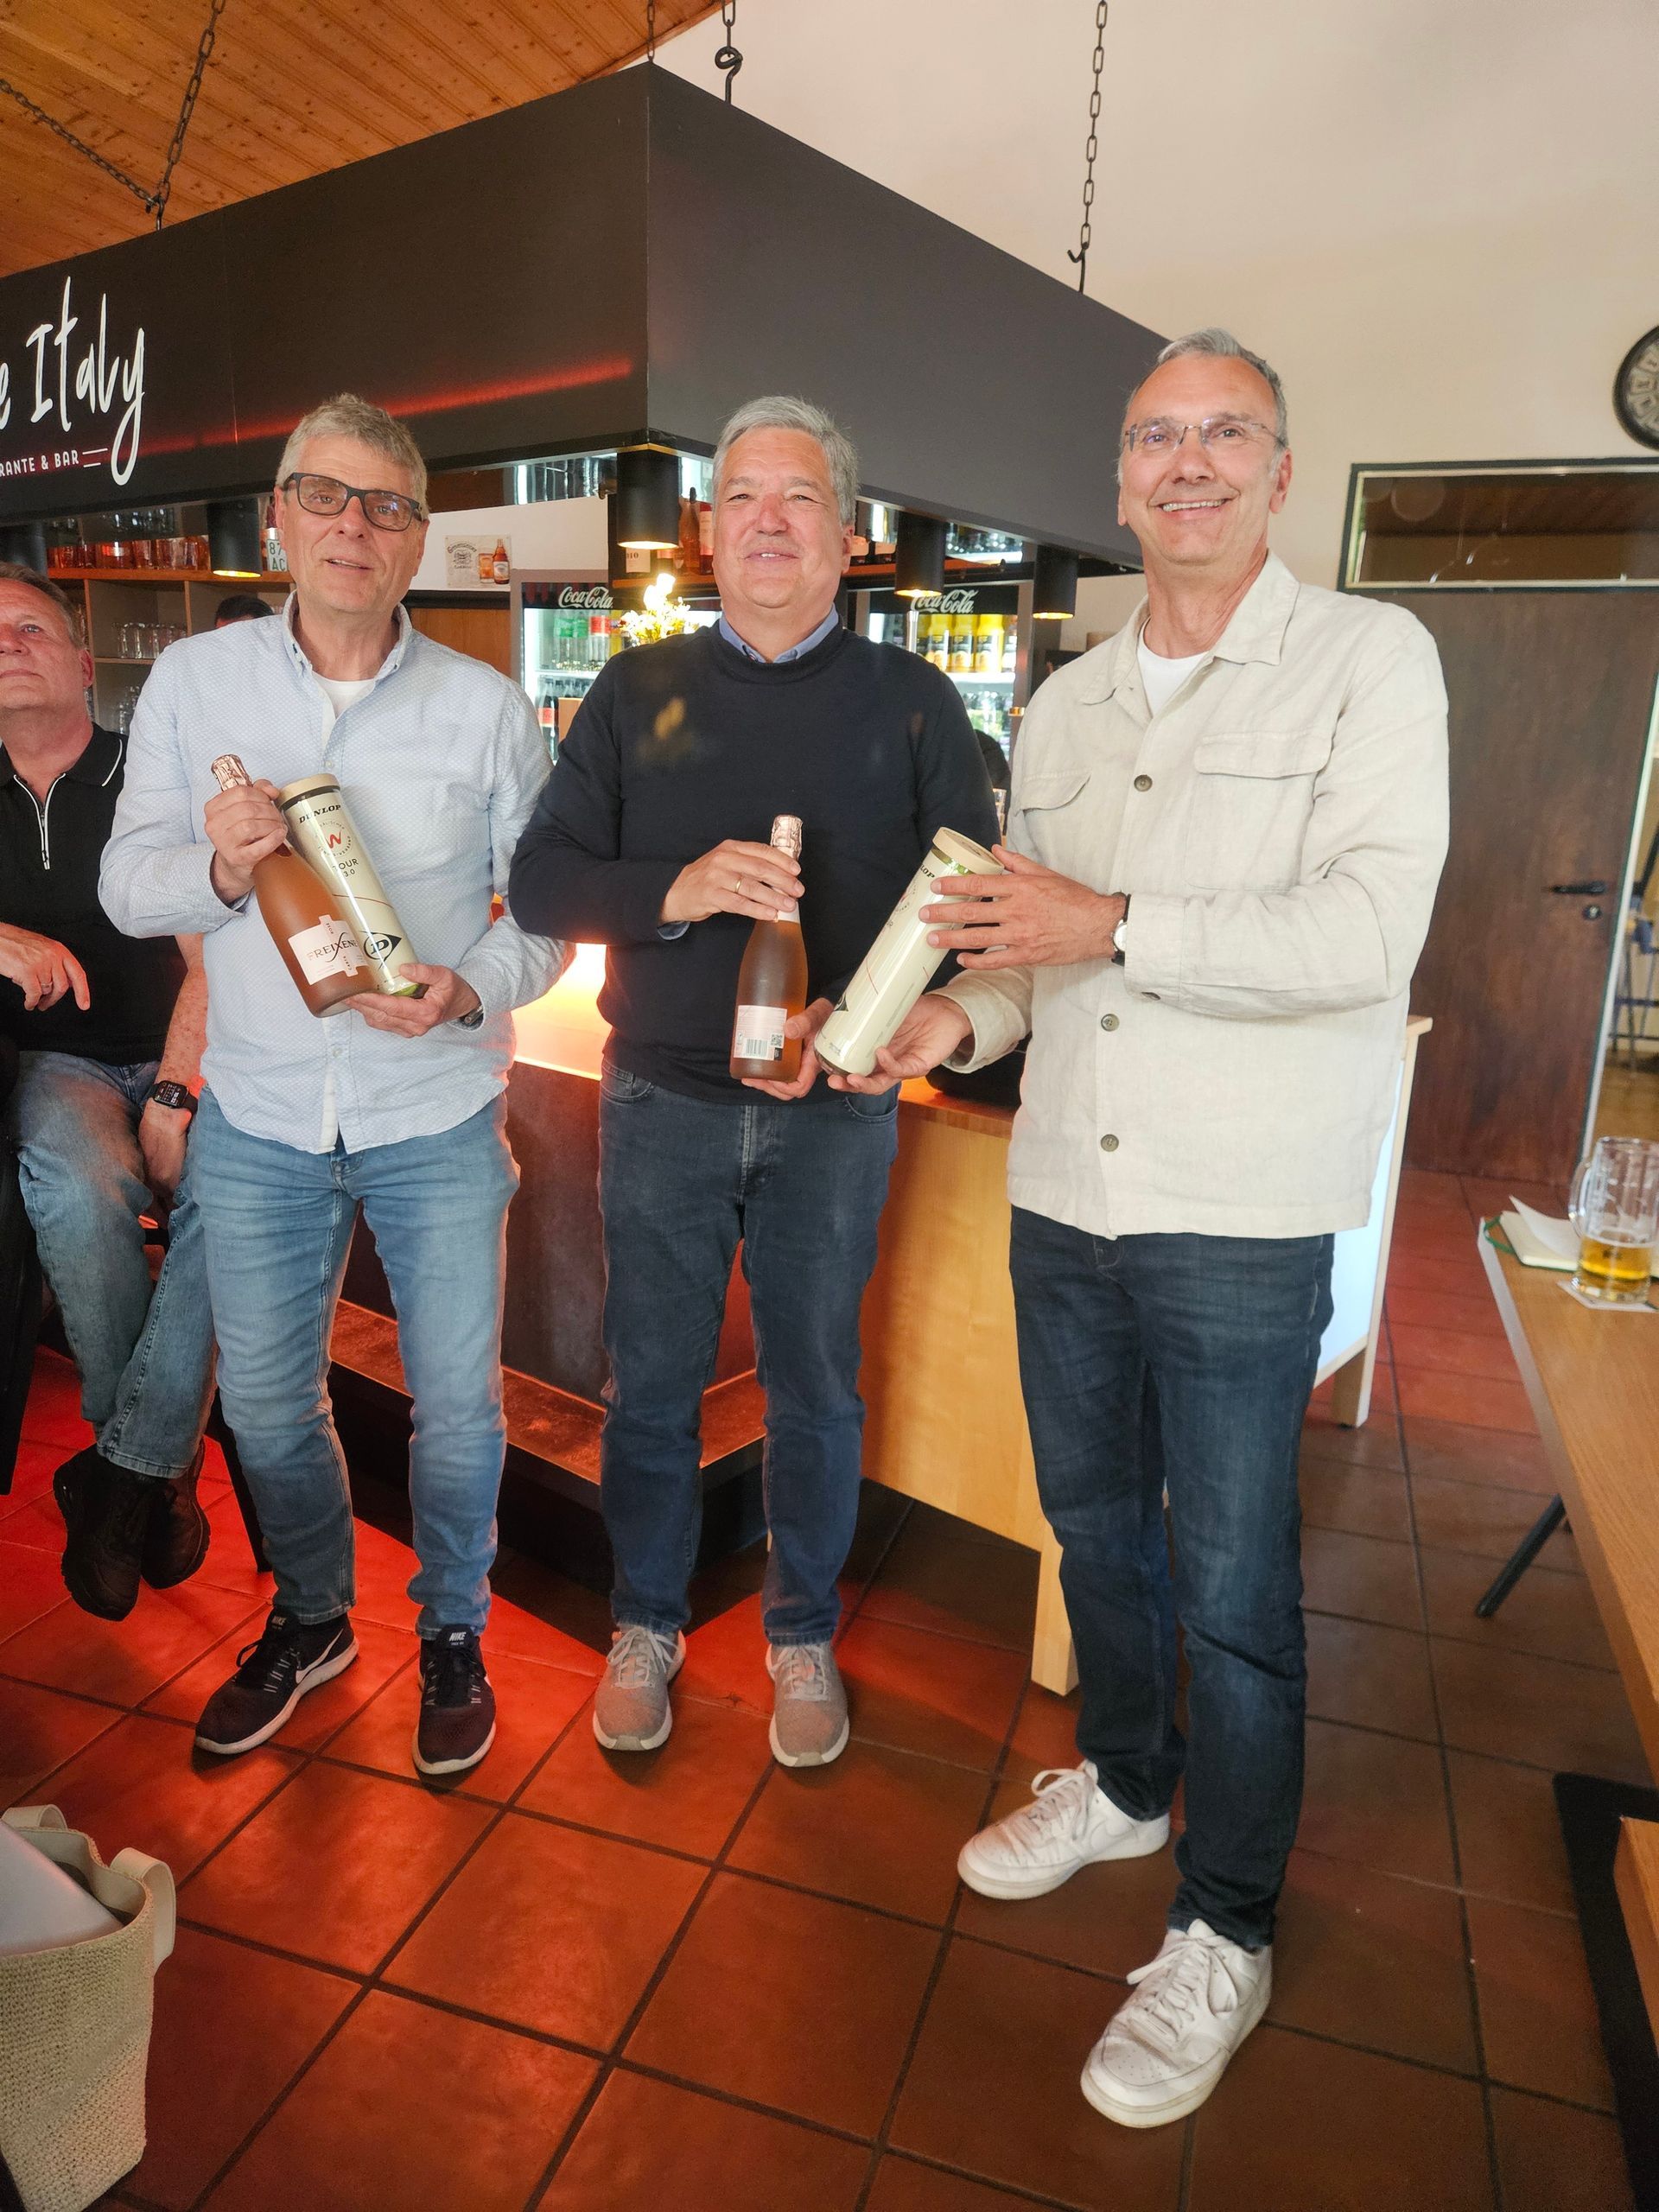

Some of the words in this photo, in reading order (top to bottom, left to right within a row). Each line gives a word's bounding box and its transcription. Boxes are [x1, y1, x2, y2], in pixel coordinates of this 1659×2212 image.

[26, 276, 145, 486] Italy
[41, 454, 49, 470] &
[54, 449, 79, 468] BAR
[448, 1631, 467, 1642] NIKE
